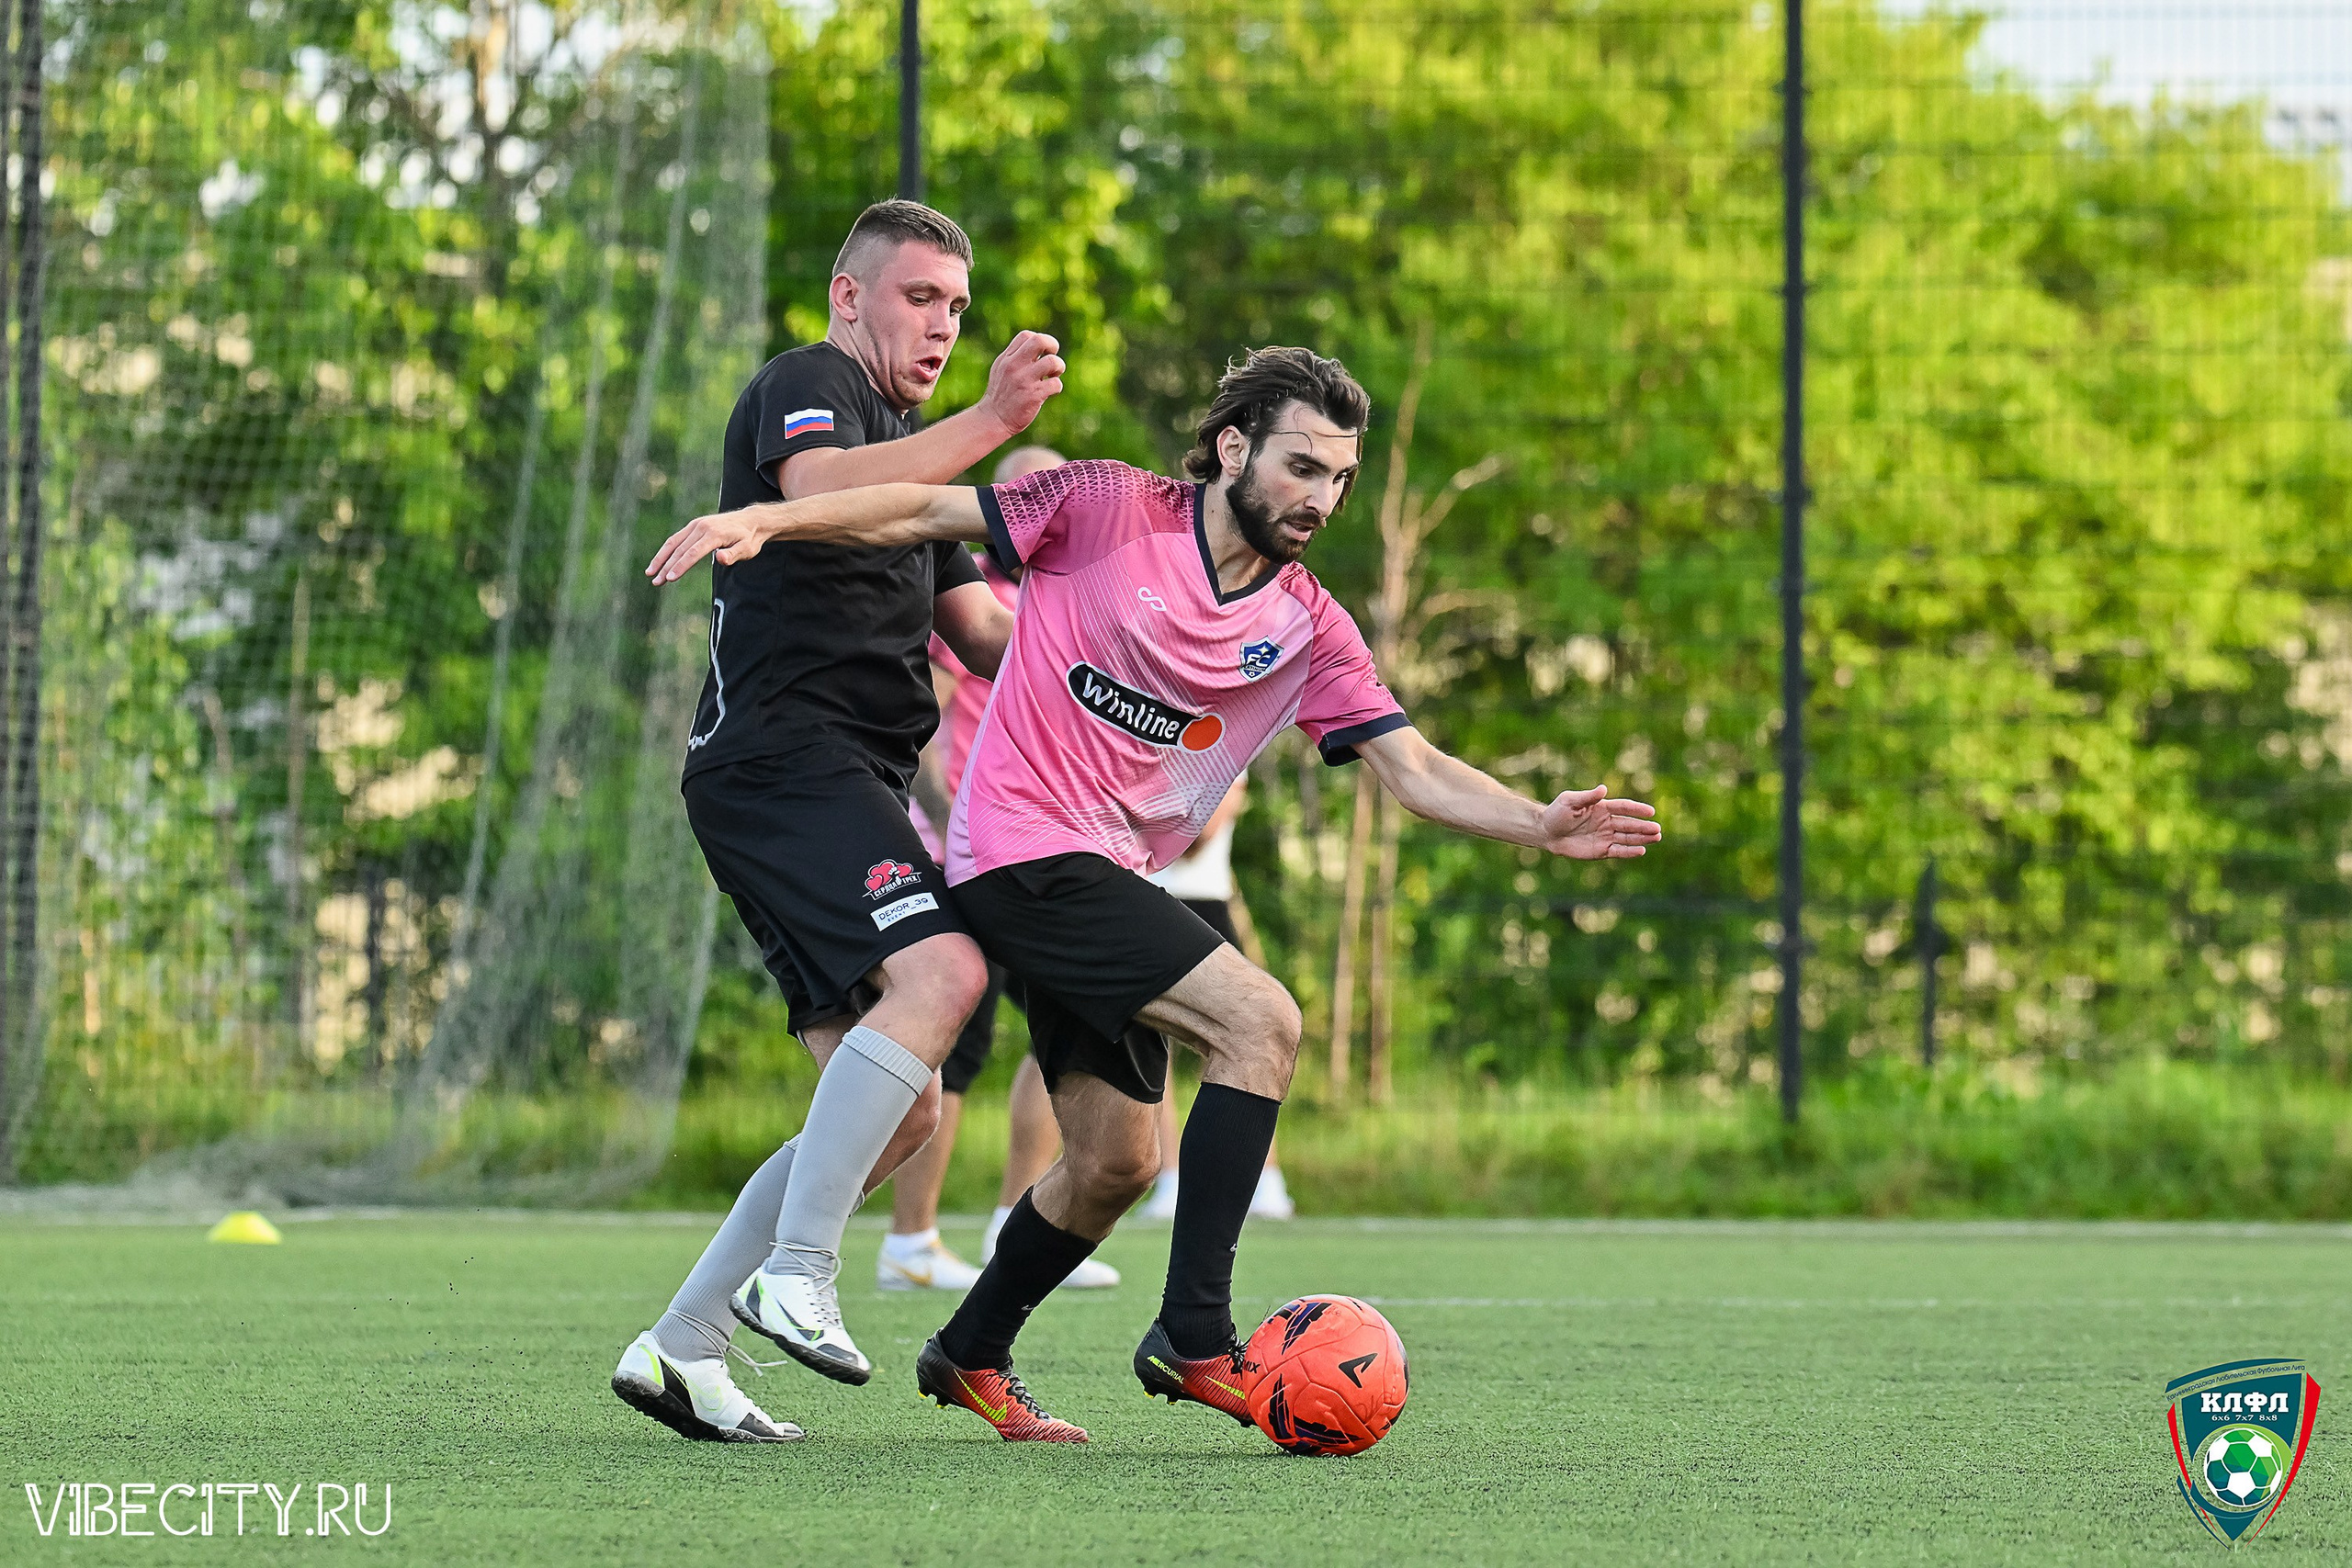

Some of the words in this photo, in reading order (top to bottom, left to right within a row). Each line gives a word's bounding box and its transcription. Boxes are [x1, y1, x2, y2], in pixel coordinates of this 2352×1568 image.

[1247, 653, 1271, 667] FC
[1082, 672, 1181, 739] Winline
[1147, 1355, 1185, 1384] MERCURIAL
